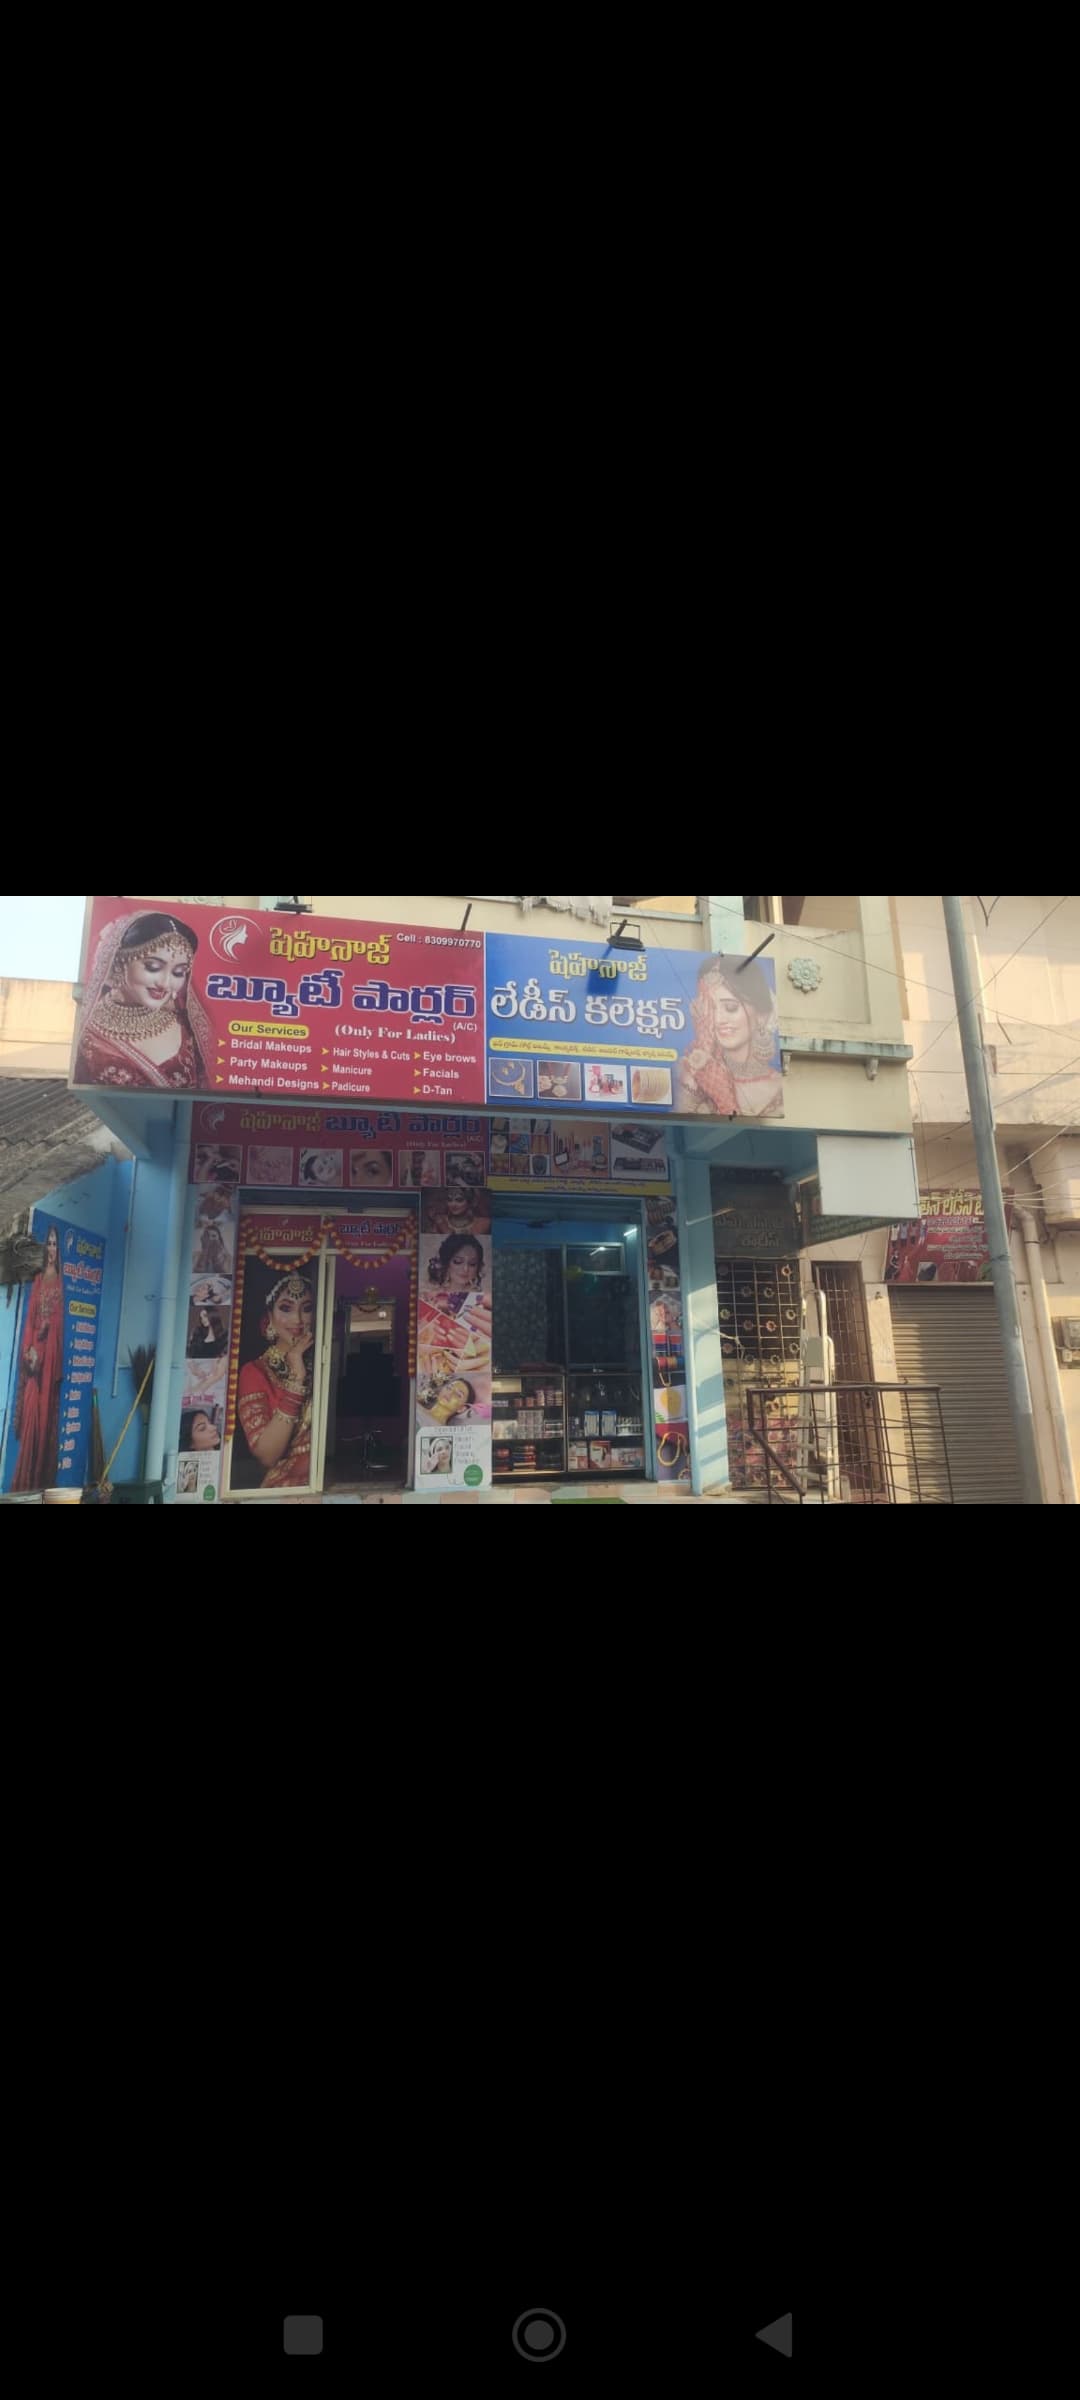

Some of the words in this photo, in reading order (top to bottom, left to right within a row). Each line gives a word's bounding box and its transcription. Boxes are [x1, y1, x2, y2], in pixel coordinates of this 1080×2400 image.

[396, 932, 416, 943] Cell
[424, 936, 481, 949] 8309970770
[206, 968, 344, 1018] బ్యూటీ
[352, 979, 477, 1025] పార్లర్
[490, 978, 577, 1024] లేడీస్
[584, 994, 686, 1039] కలెక్షన్
[231, 1022, 254, 1033] Our
[256, 1024, 307, 1038] Services
[335, 1024, 372, 1039] (Only
[378, 1027, 403, 1039] For
[406, 1029, 456, 1044] Ladies)
[453, 1021, 478, 1033] (A/C)
[231, 1038, 263, 1051] Bridal
[265, 1041, 312, 1055] Makeups
[333, 1047, 351, 1058] Hair
[353, 1048, 379, 1060] Styles
[381, 1050, 388, 1060] &
[390, 1050, 410, 1061] Cuts
[230, 1056, 258, 1070] Party
[261, 1058, 308, 1072] Makeups
[423, 1051, 442, 1064] Eye
[445, 1053, 477, 1064] brows
[332, 1063, 373, 1076] Manicure
[423, 1067, 460, 1079] Facials
[228, 1074, 275, 1088] Mehandi
[277, 1077, 319, 1091] Designs
[331, 1081, 371, 1093] Padicure
[422, 1085, 453, 1096] D-Tan
